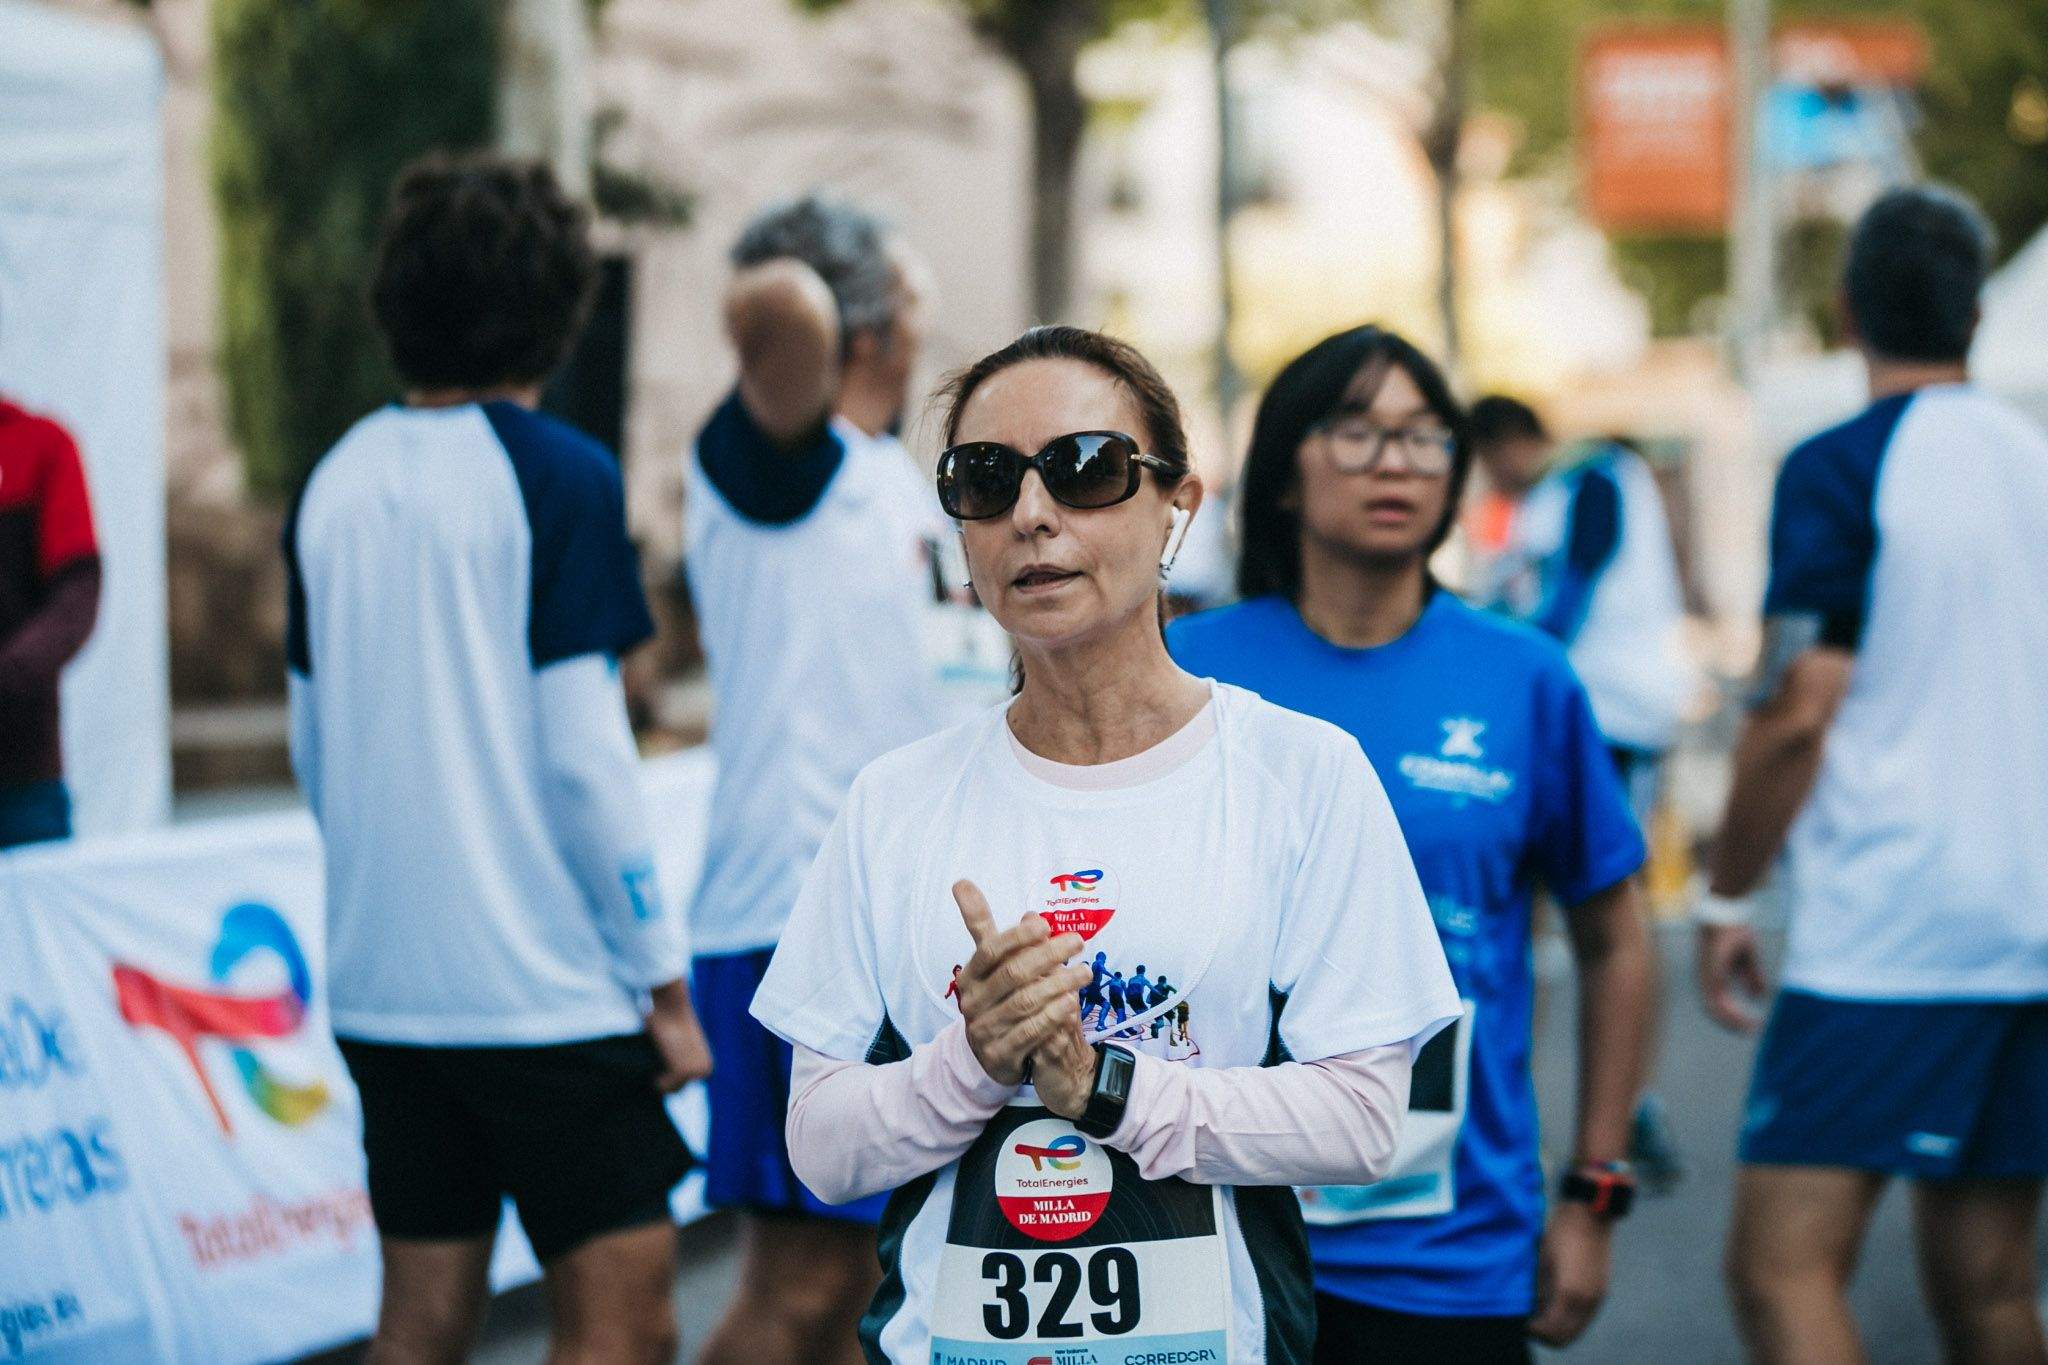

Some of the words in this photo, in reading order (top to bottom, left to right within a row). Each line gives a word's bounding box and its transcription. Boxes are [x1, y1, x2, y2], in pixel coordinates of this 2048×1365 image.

[1054, 912, 1086, 922] MILLA
[1056, 922, 1097, 932] MADRID
[1016, 1177, 1089, 1188] TotalEnergies
[1033, 1199, 1075, 1211] MILLA
[1019, 1213, 1037, 1224] DE
[1039, 1211, 1092, 1224] MADRID
[982, 1247, 1141, 1339] 329
